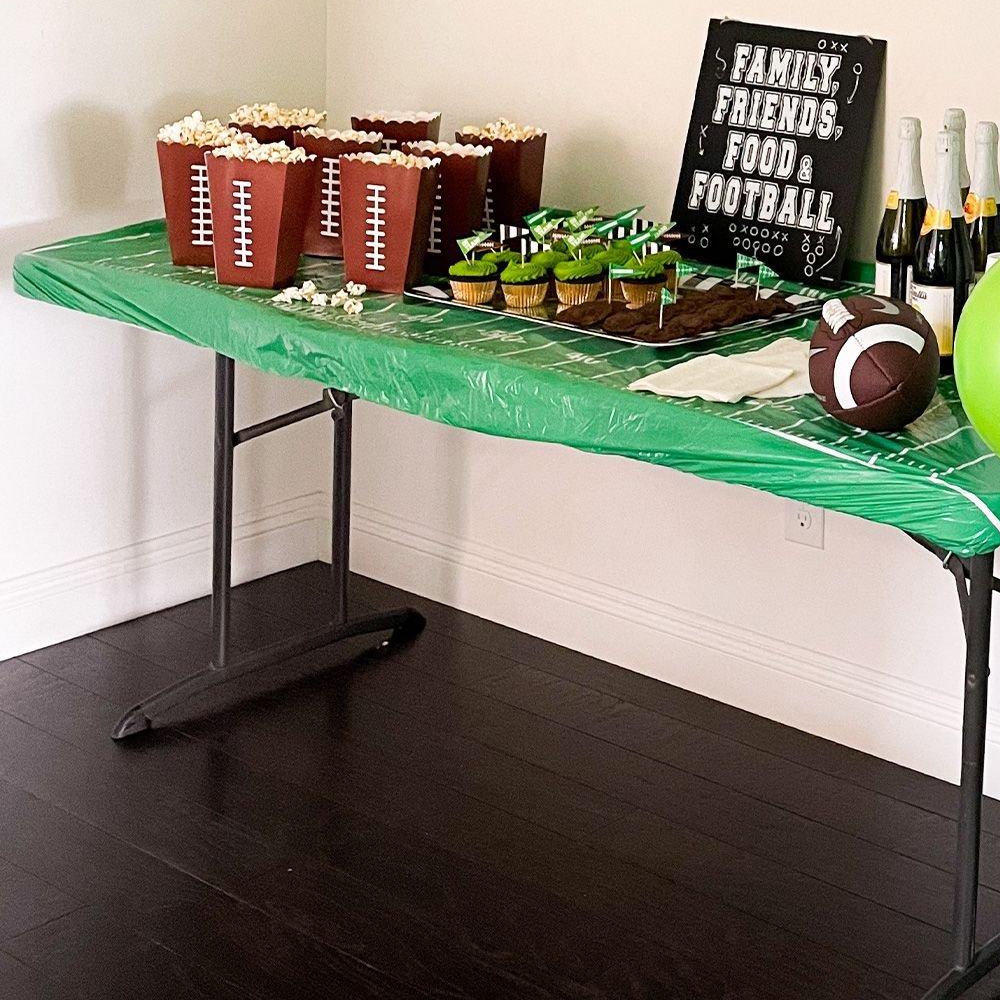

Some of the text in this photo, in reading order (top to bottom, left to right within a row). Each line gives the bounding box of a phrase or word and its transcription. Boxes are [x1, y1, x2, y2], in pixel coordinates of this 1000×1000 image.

[730, 43, 842, 97] FAMILY,
[712, 85, 843, 141] FRIENDS,
[722, 131, 812, 183] FOOD &
[688, 170, 834, 234] FOOTBALL
